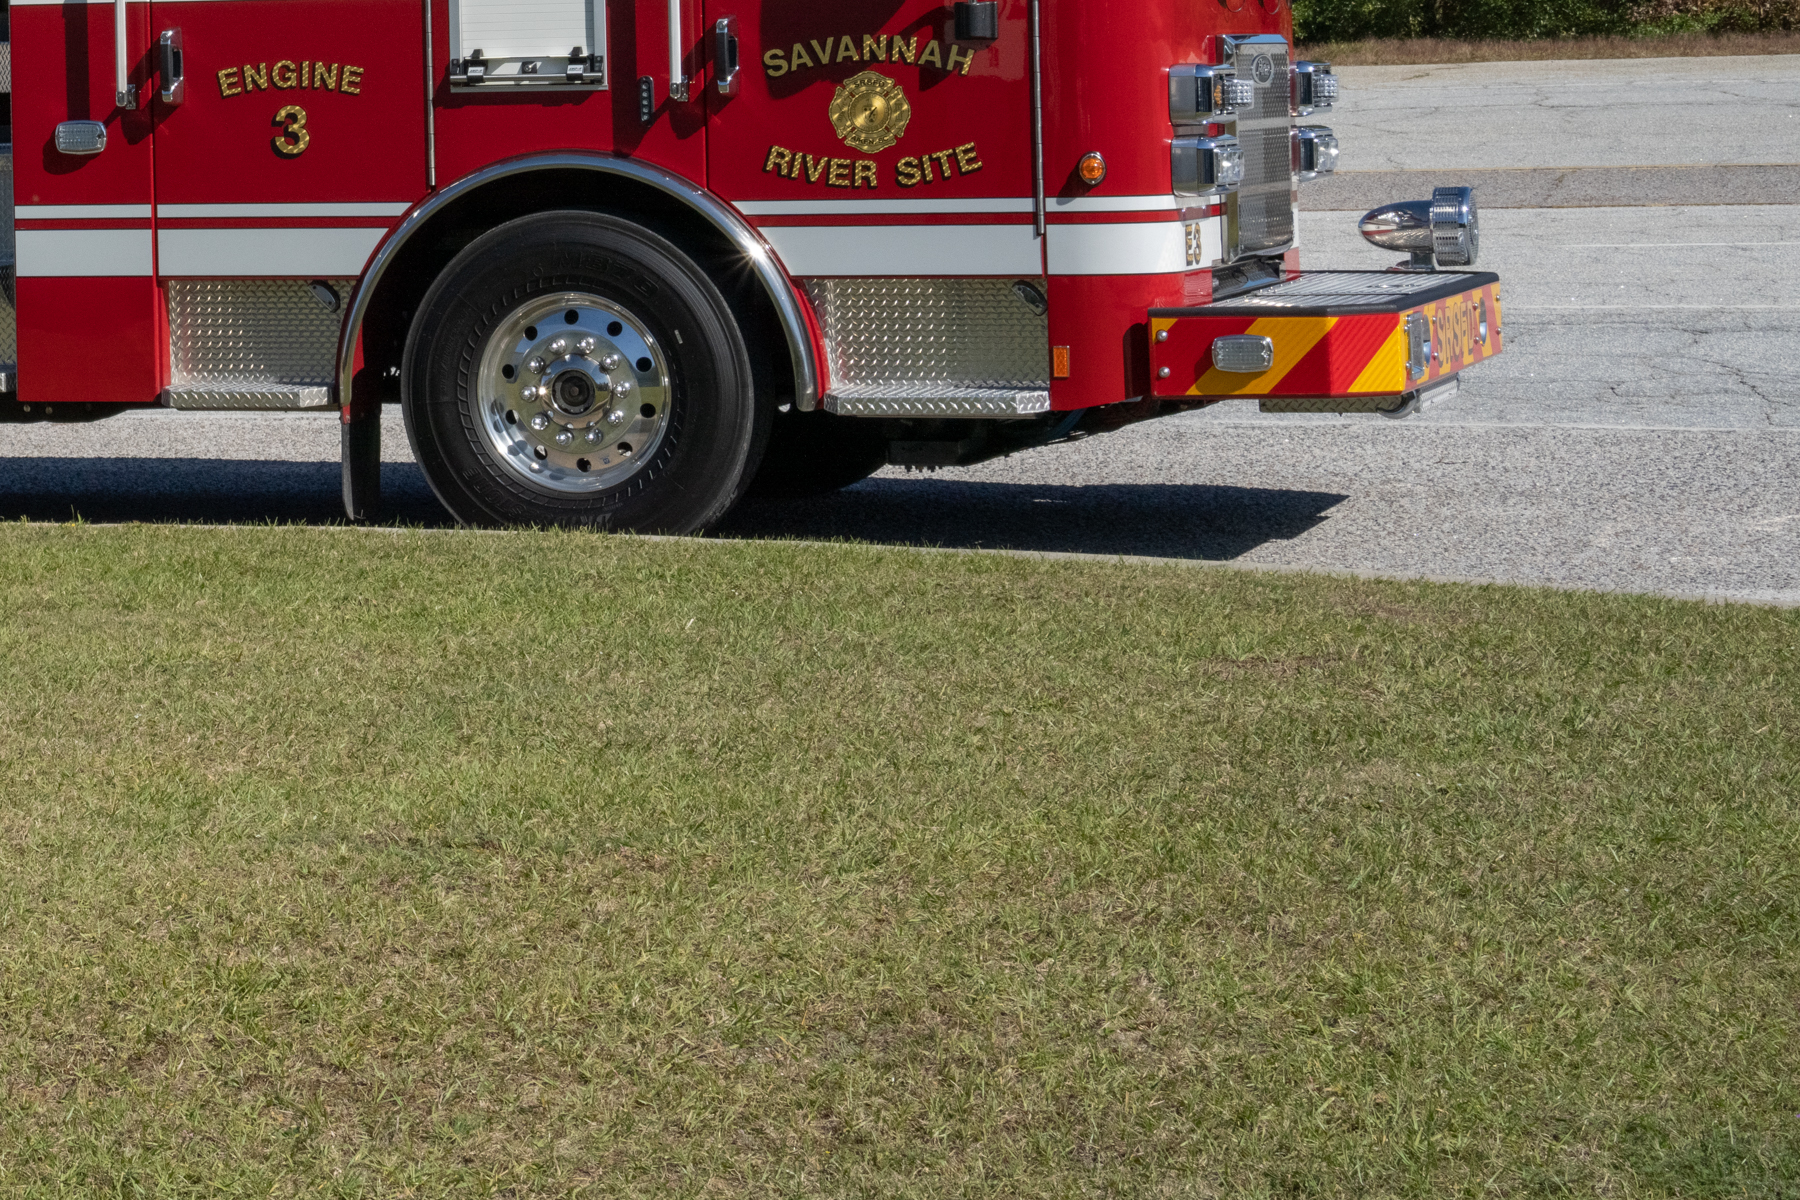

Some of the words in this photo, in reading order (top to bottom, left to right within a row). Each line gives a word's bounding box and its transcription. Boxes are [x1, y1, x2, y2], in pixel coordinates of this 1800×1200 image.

[763, 34, 974, 77] SAVANNAH
[216, 60, 364, 98] ENGINE
[271, 105, 310, 158] 3
[763, 145, 878, 189] RIVER
[896, 141, 983, 186] SITE
[1185, 222, 1202, 266] E3
[1436, 300, 1475, 368] SRSFD
